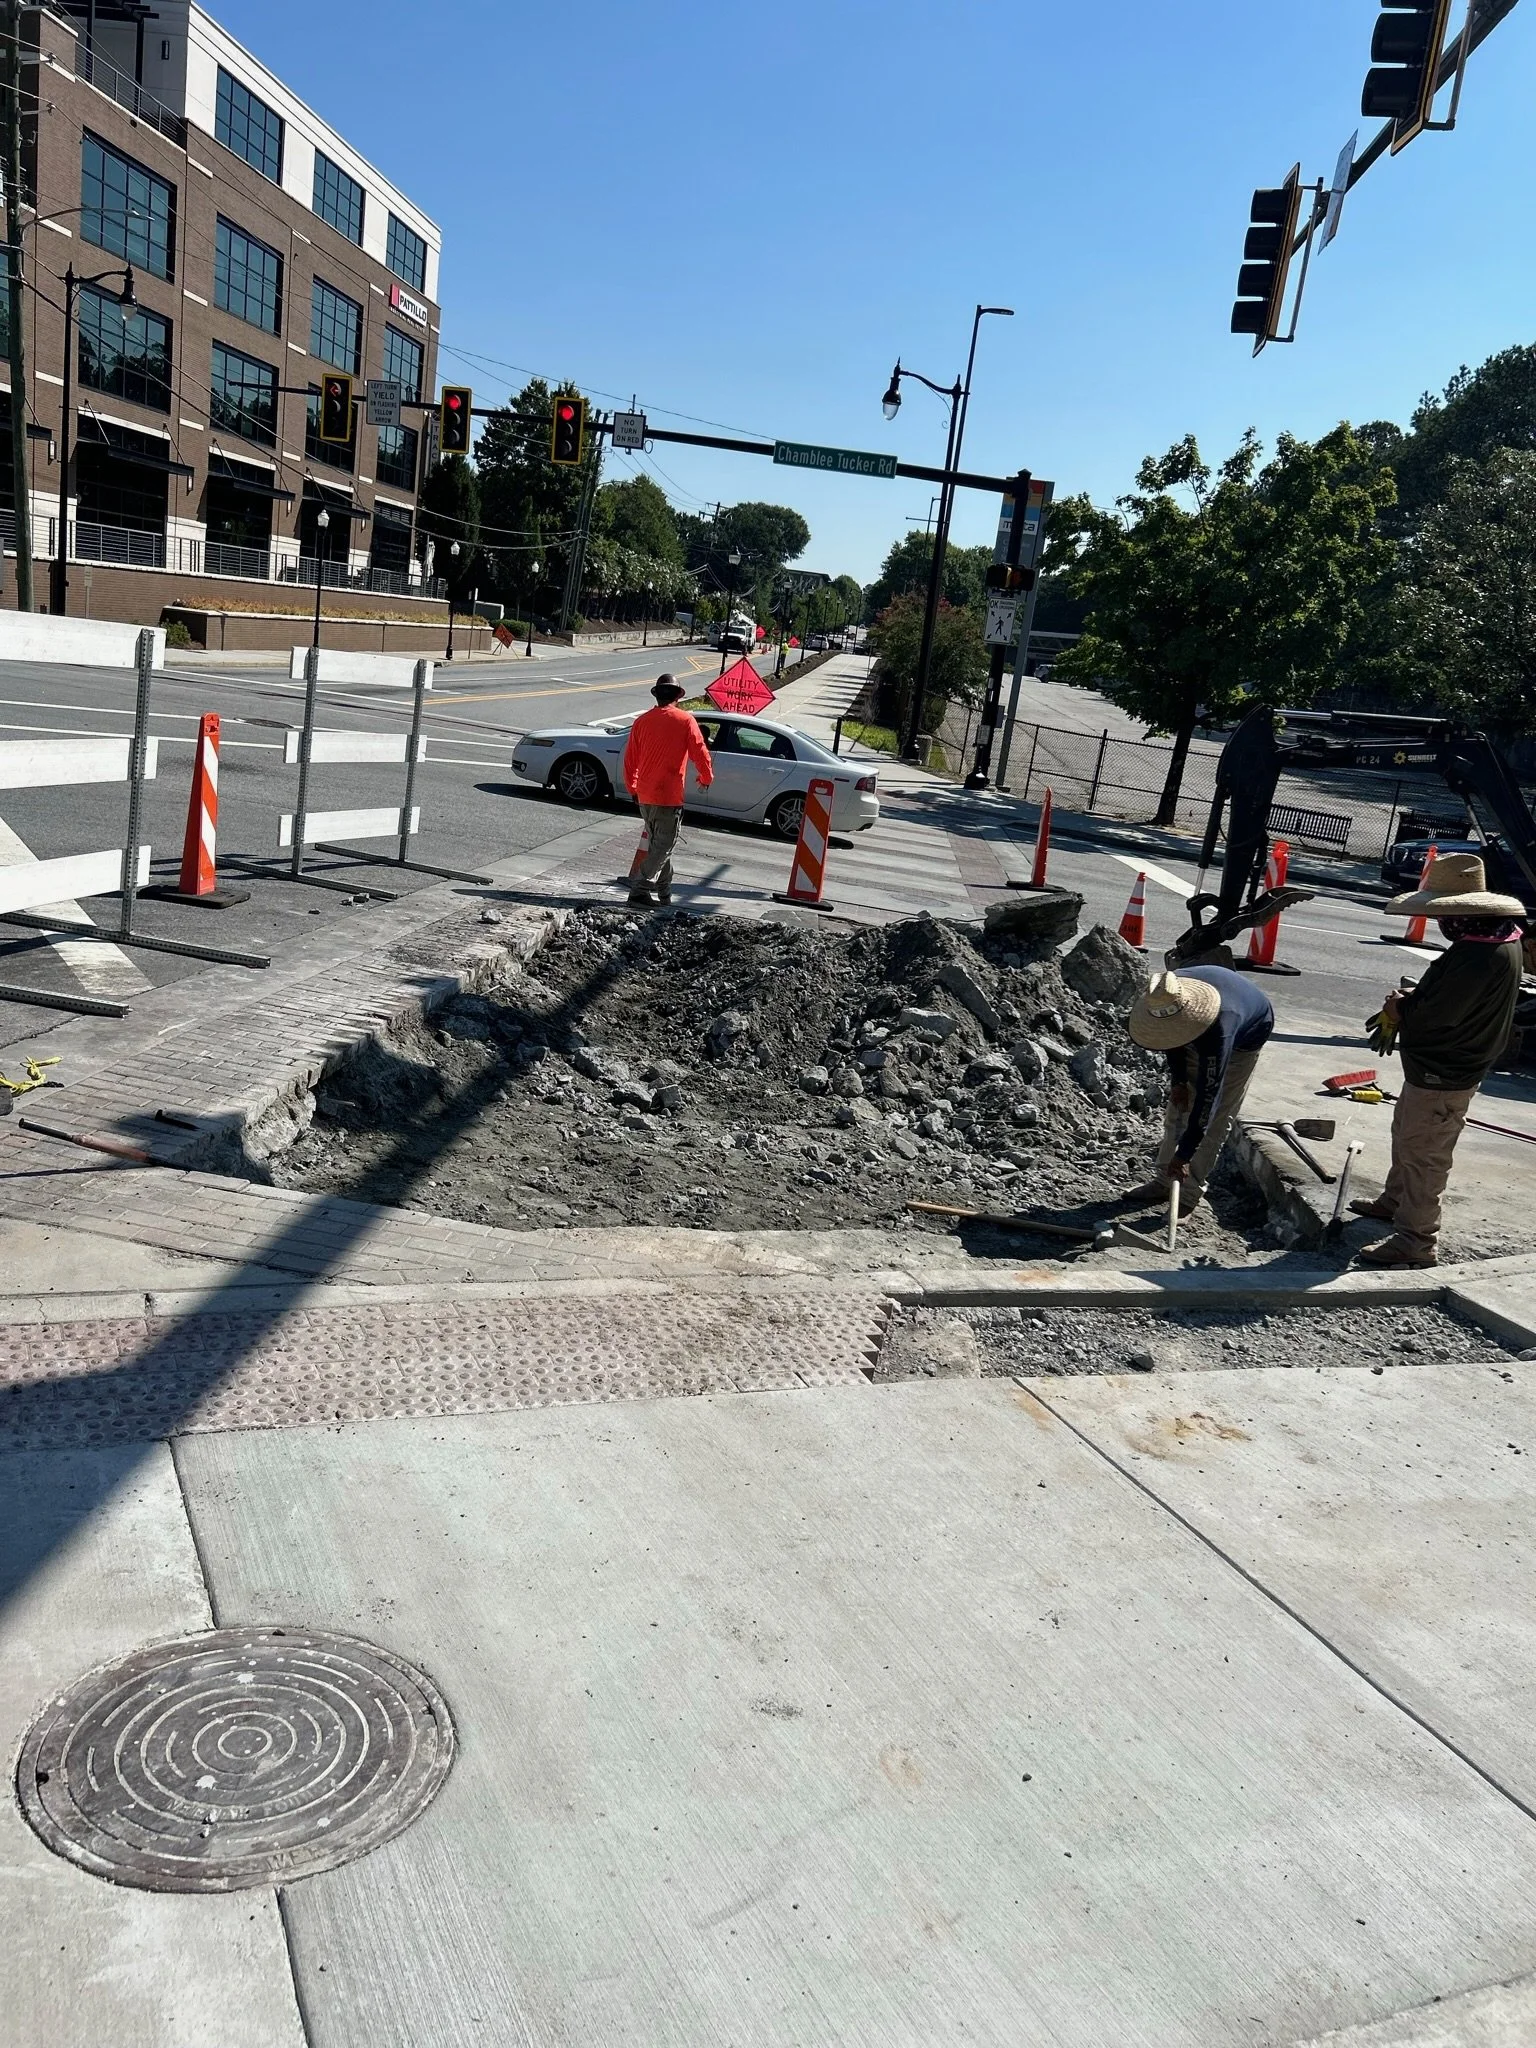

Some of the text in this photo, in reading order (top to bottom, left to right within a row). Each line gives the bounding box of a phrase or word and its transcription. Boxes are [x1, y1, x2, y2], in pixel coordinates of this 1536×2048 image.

[400, 294, 427, 322] PATTILLO
[373, 391, 395, 400] YIELD
[616, 434, 626, 442] ON
[778, 445, 893, 475] Chamblee Tucker Rd
[723, 677, 760, 689] UTILITY
[726, 689, 753, 701] WORK
[722, 701, 755, 713] AHEAD
